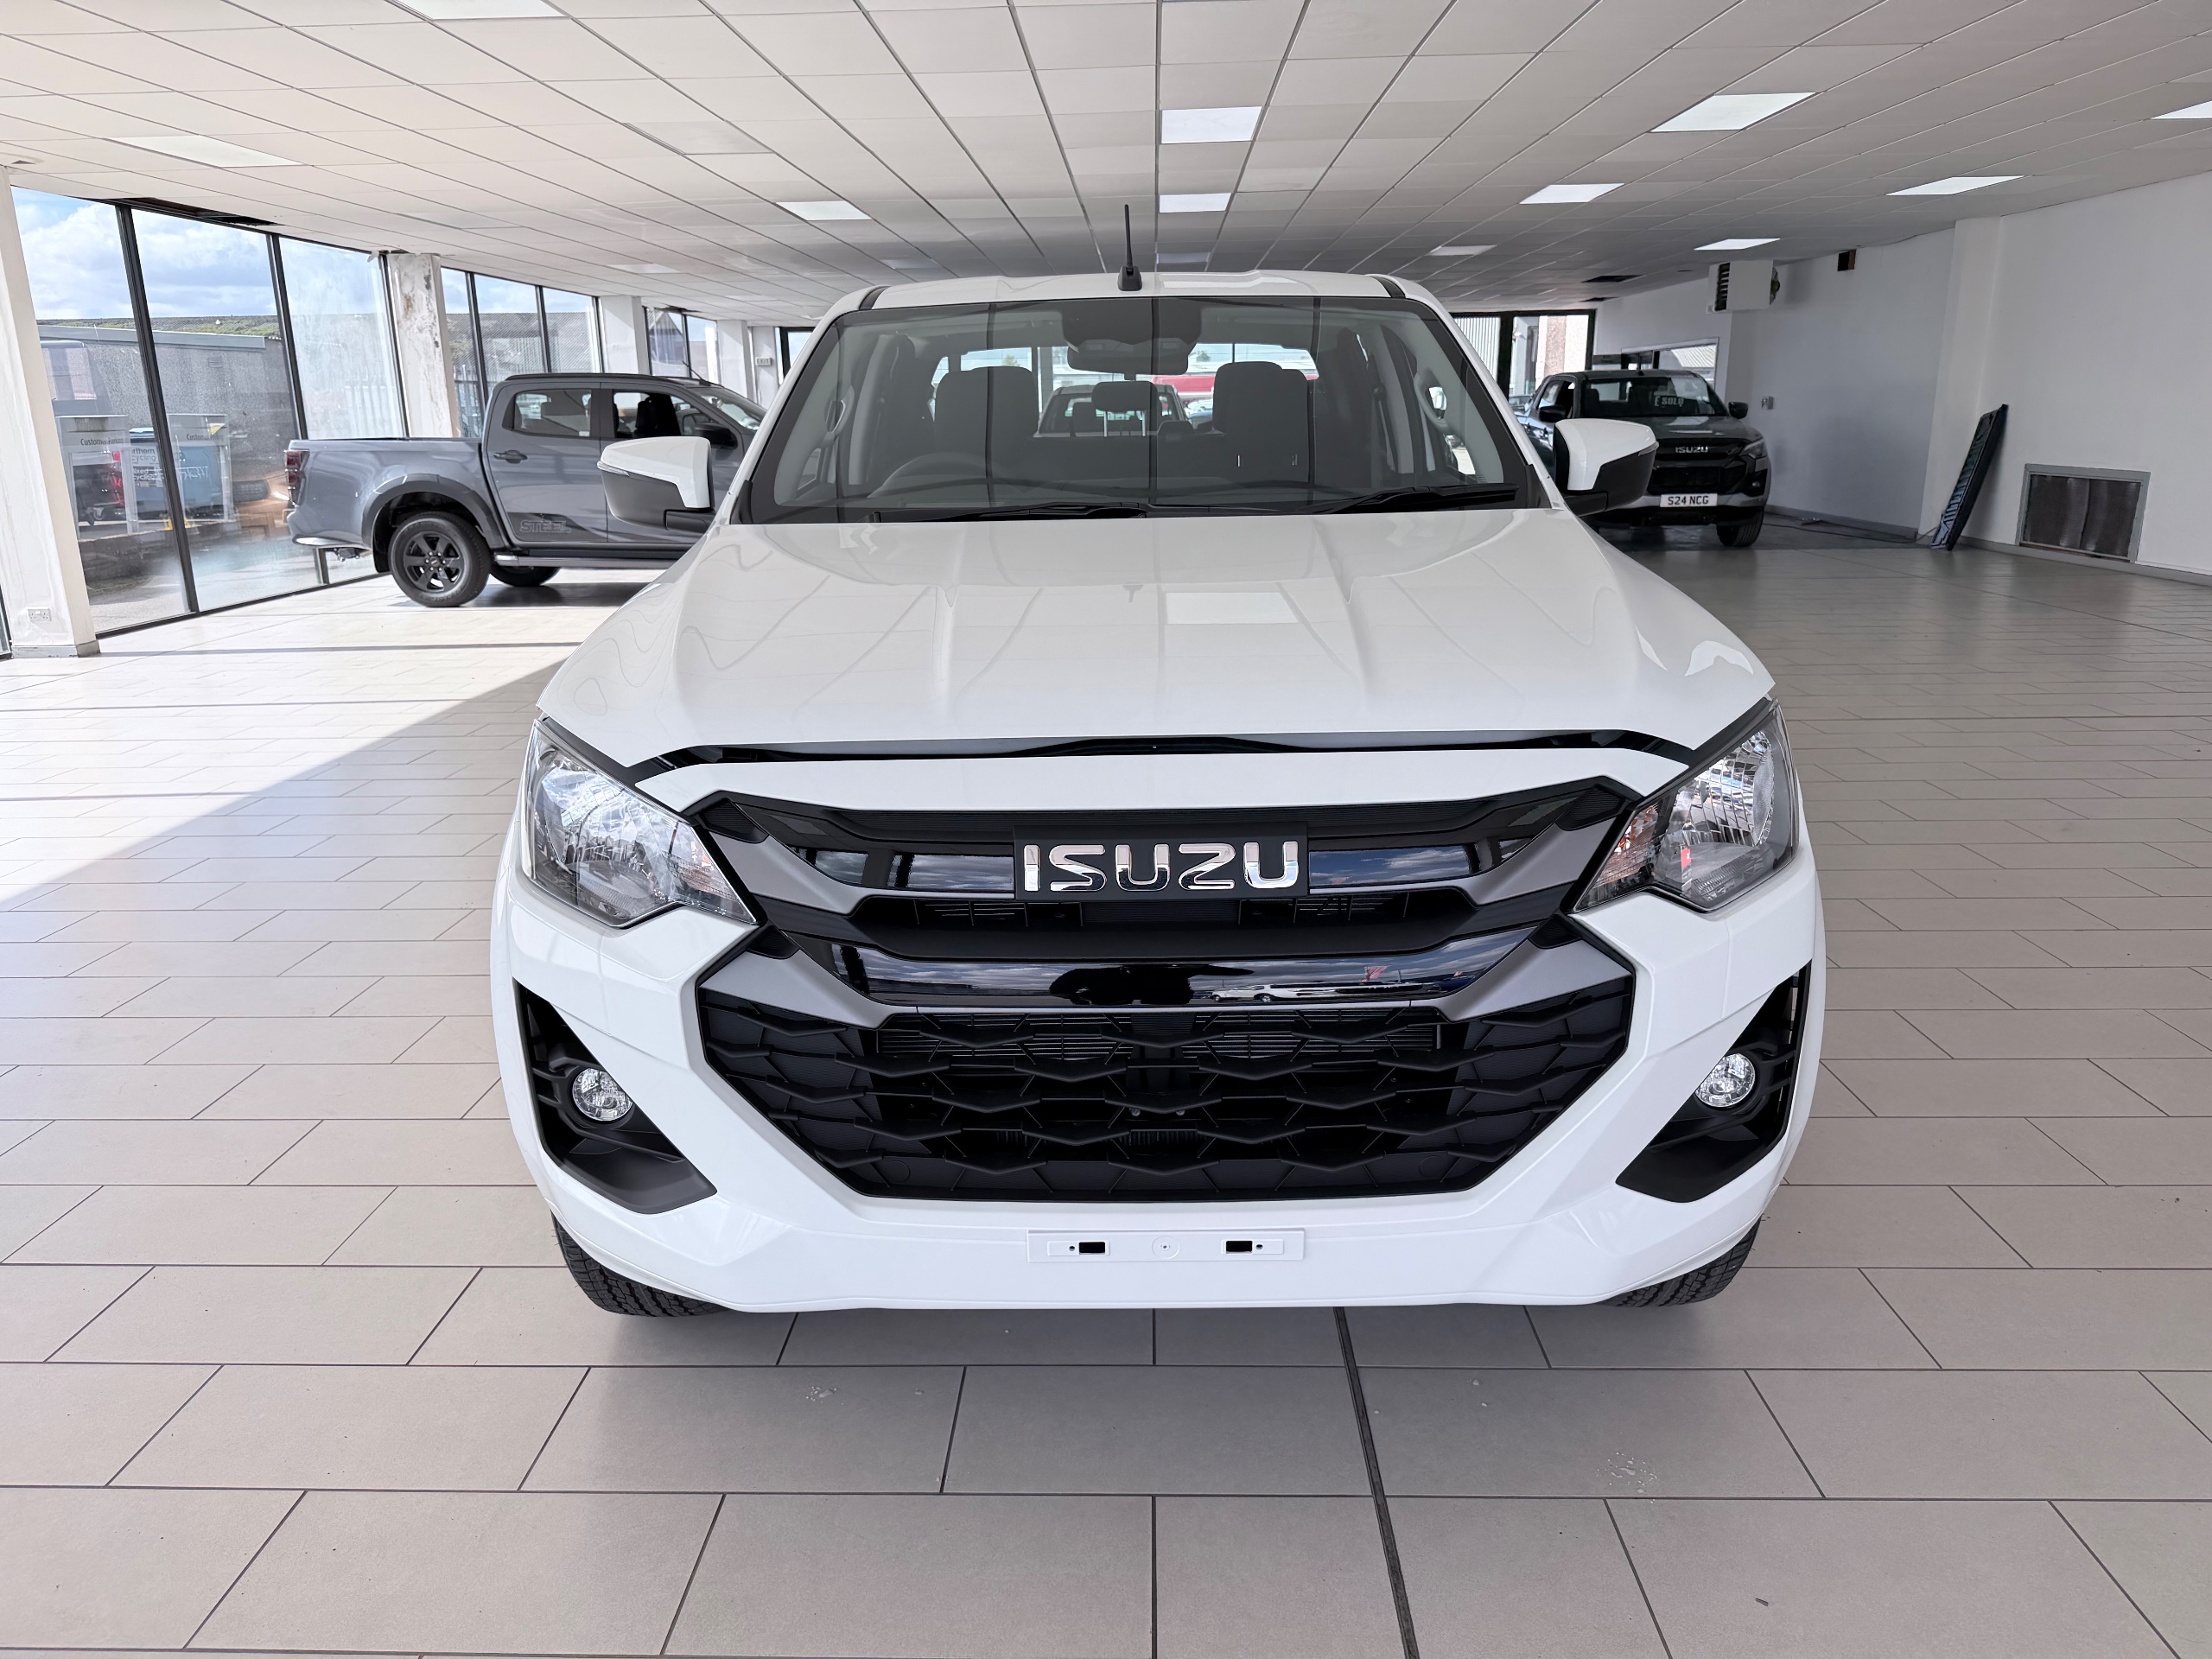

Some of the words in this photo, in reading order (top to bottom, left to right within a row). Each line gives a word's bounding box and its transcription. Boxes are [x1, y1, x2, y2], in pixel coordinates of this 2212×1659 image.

[1668, 496, 1687, 505] S24
[1689, 495, 1709, 505] NCG
[519, 519, 572, 533] STEEL
[1024, 840, 1300, 892] ISUZU
